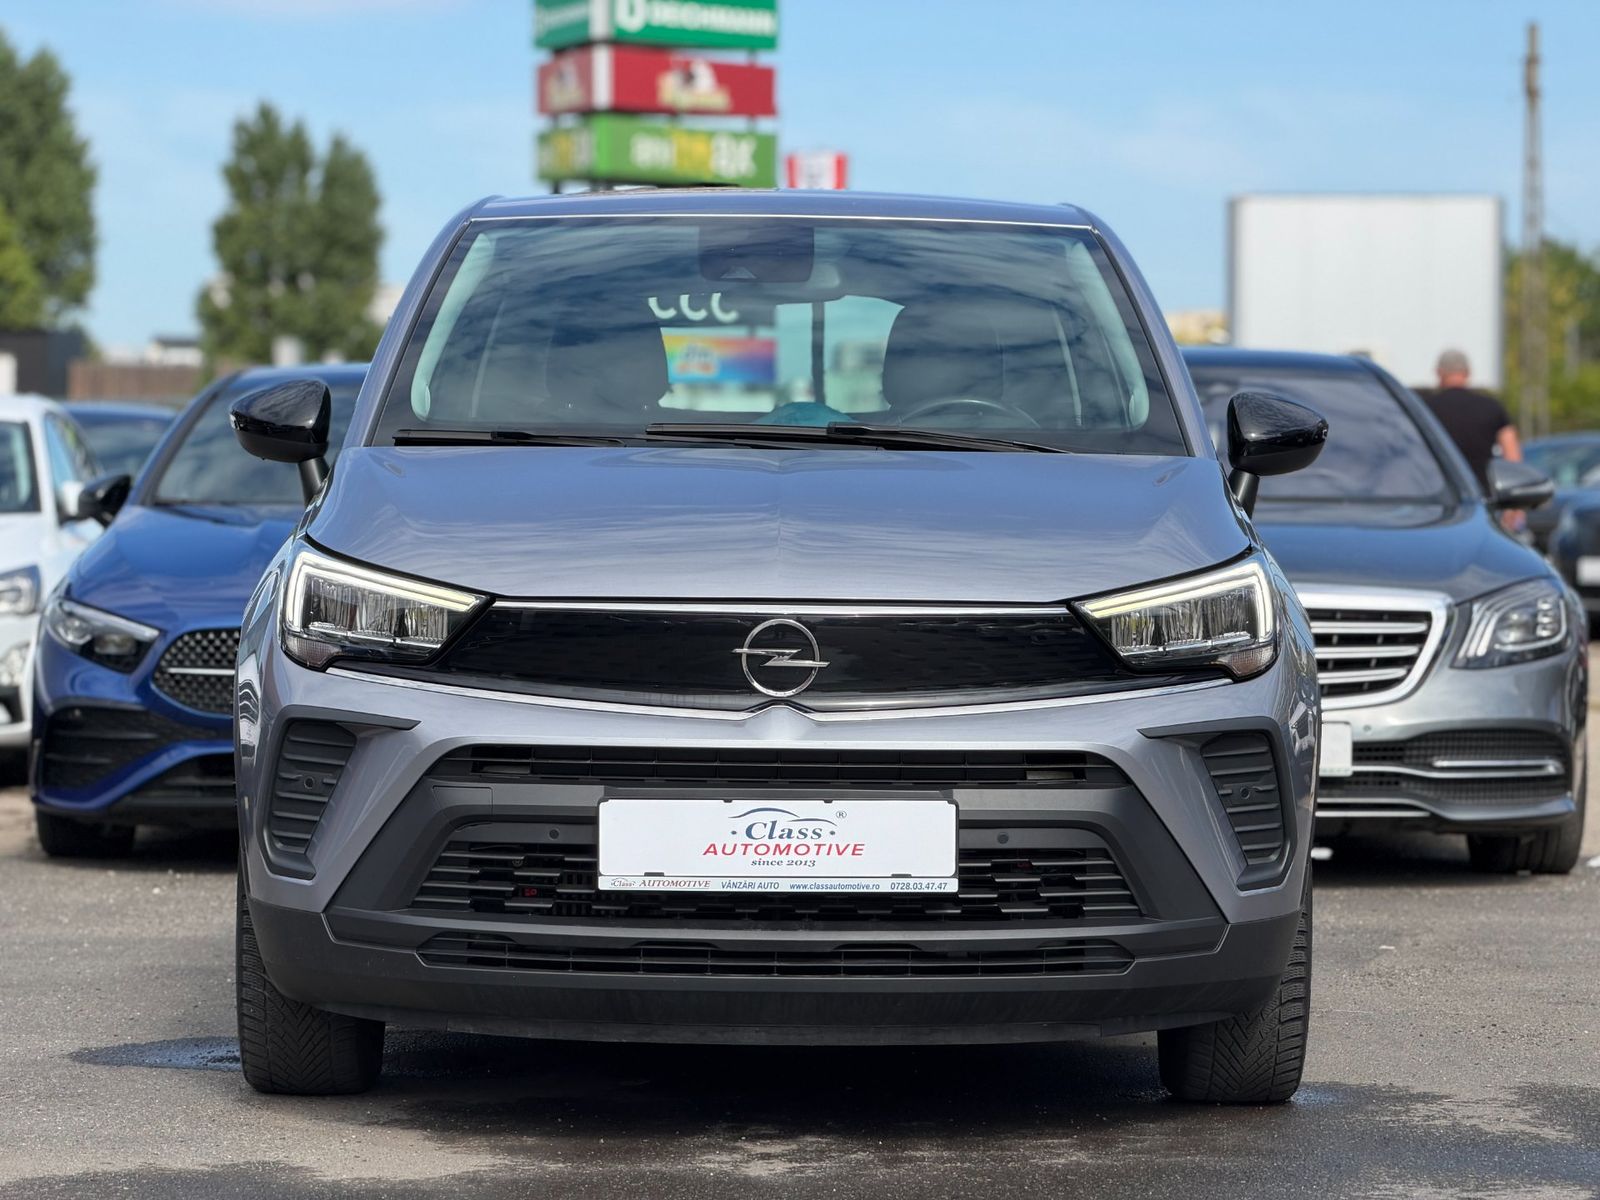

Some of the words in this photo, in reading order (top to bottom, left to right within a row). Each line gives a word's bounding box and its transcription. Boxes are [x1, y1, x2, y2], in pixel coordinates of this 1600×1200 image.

[745, 820, 823, 840] Class
[702, 843, 865, 856] AUTOMOTIVE
[750, 858, 784, 867] since
[786, 858, 817, 868] 2013
[639, 879, 711, 888] AUTOMOTIVE
[758, 881, 780, 890] AUTO
[789, 881, 881, 891] www.classautomotive.ro
[890, 882, 948, 891] 0728.03.47.47
